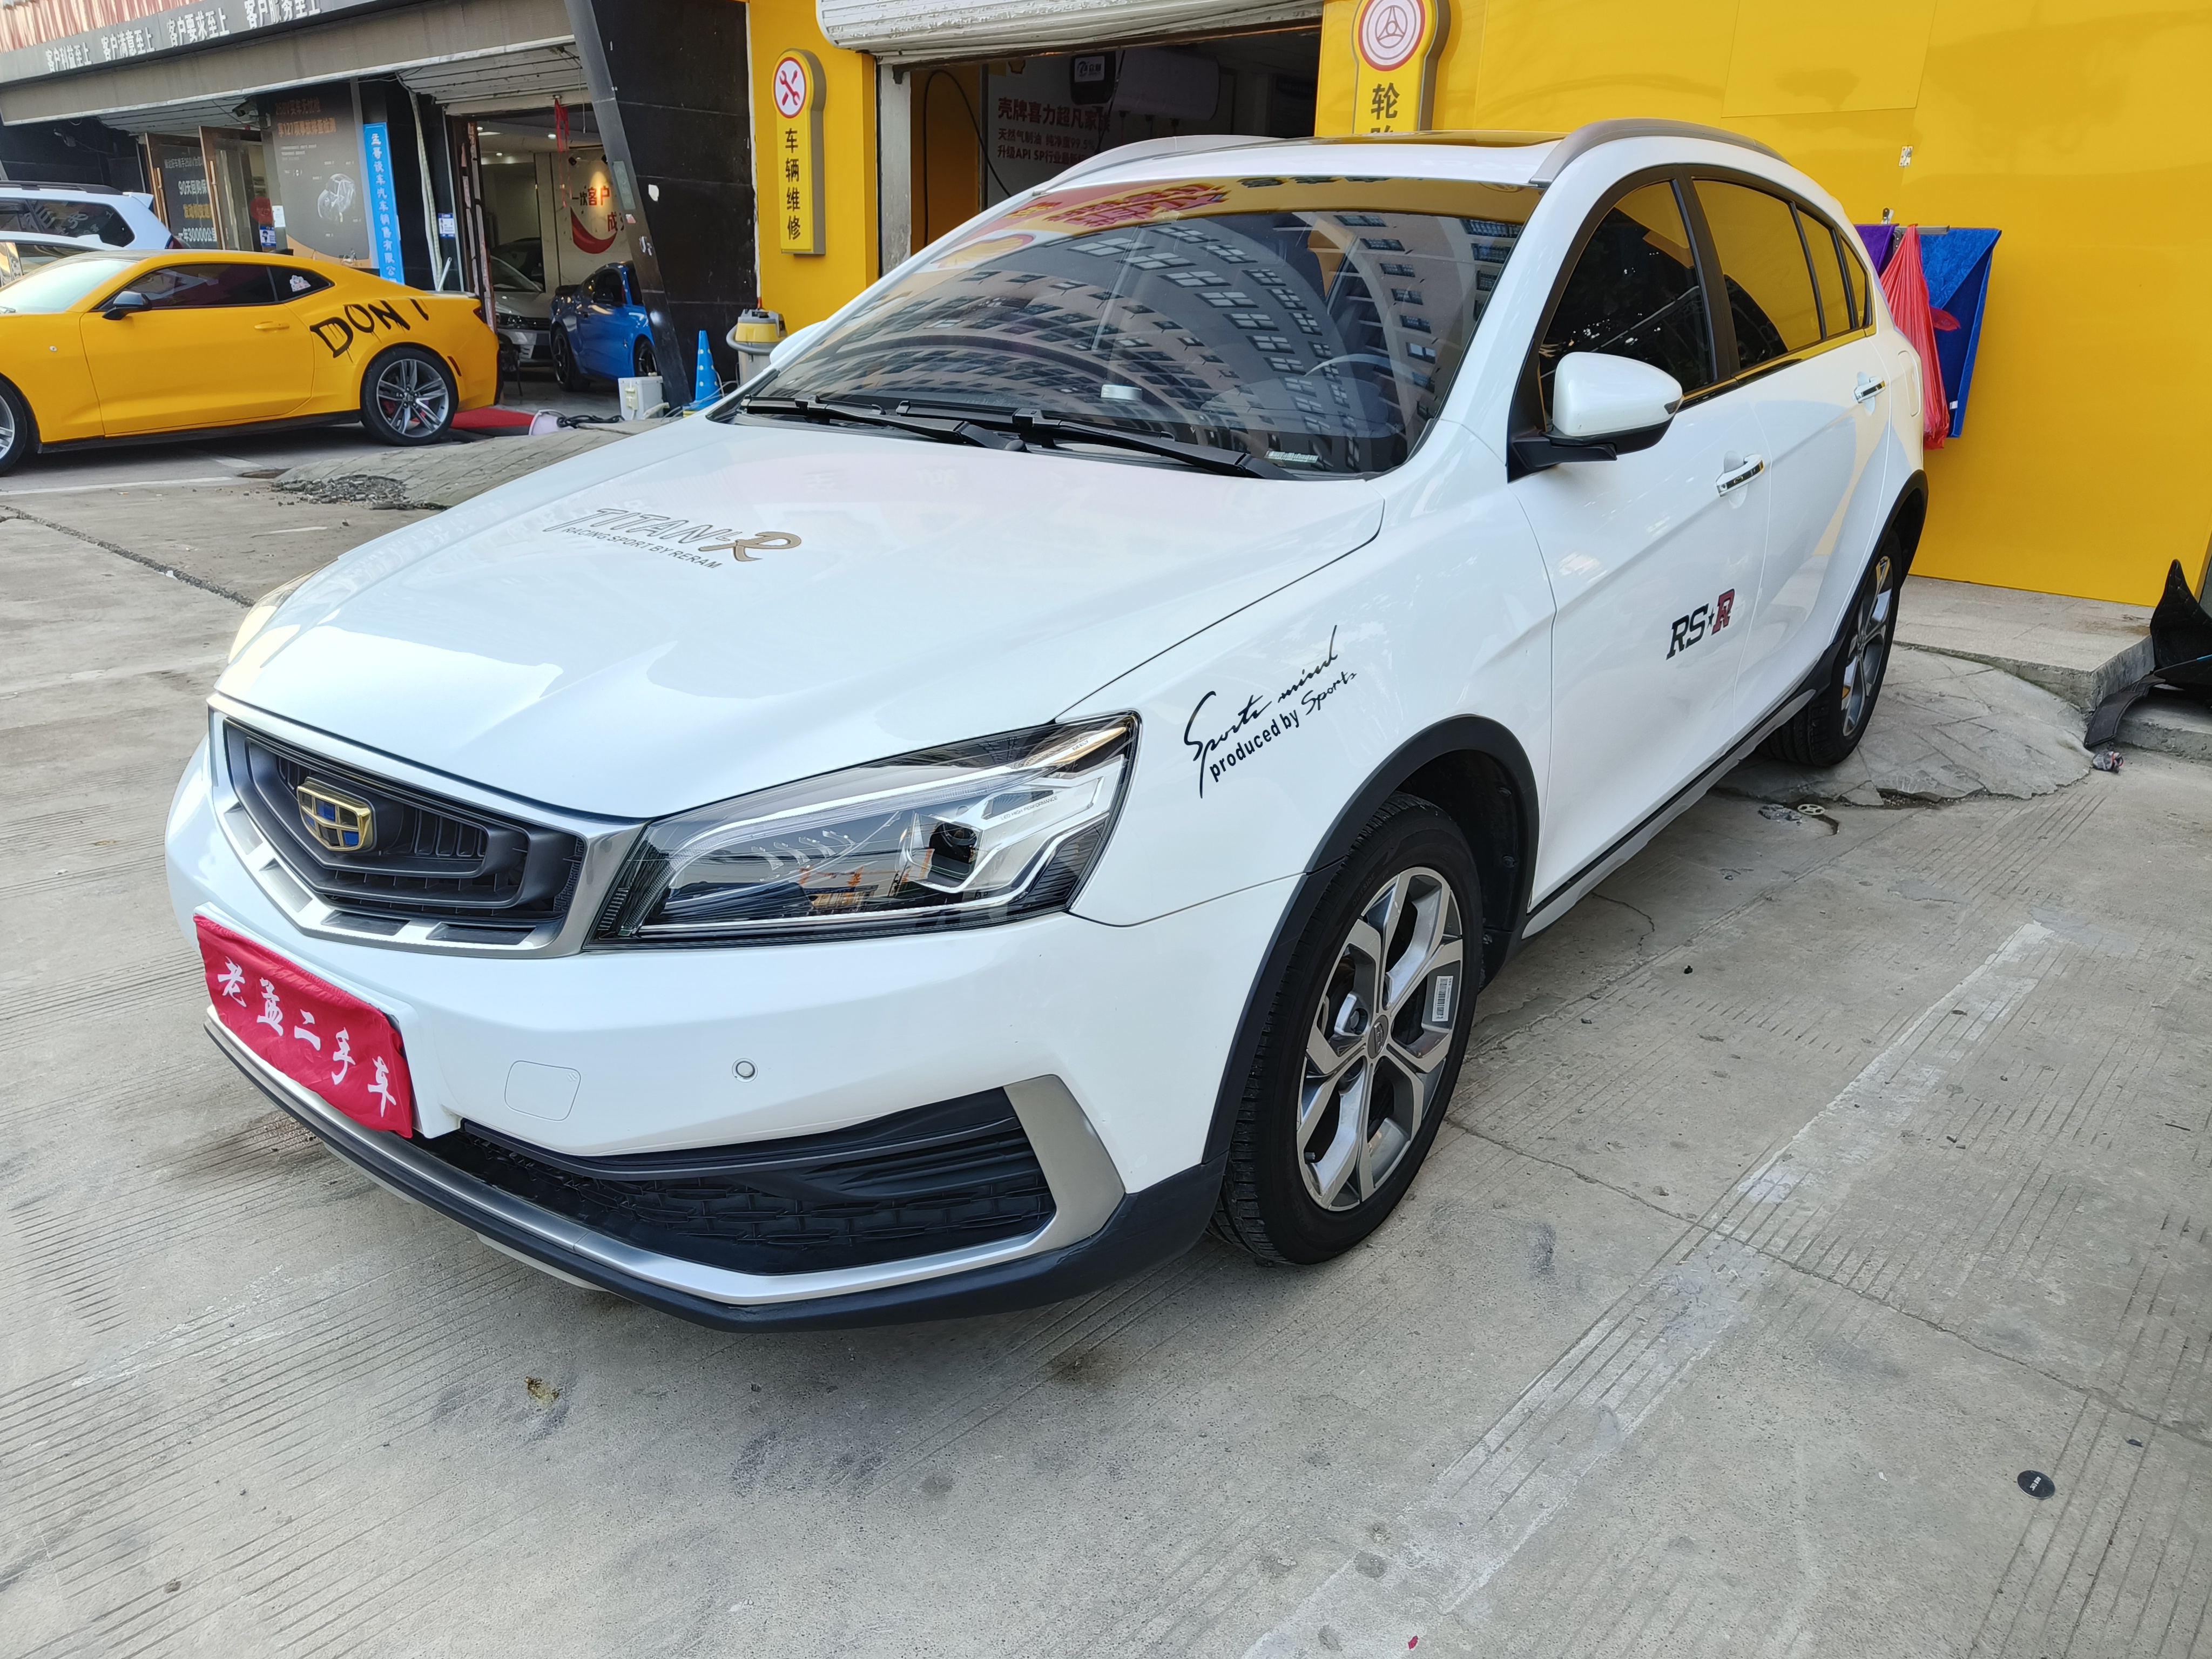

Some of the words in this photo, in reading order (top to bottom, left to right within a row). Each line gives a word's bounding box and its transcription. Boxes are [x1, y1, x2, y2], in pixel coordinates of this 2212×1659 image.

[46, 42, 92, 72] 客户利益至上
[101, 27, 156, 61] 客户满意至上
[167, 8, 230, 47] 客户要求至上
[998, 97, 1111, 133] 壳牌喜力超凡家族
[1371, 83, 1400, 133] 轮
[998, 128, 1042, 145] 天然气制油
[785, 128, 801, 240] 车辆维修
[562, 527, 610, 539] RACING
[607, 535, 655, 549] SPORT
[649, 545, 673, 554] BY
[667, 550, 723, 569] RERAM
[1278, 624, 1338, 703] mind
[1210, 719, 1281, 783] produced
[1279, 709, 1299, 728] by
[1301, 671, 1357, 716] Sports
[1023, 795, 1058, 812] PERFORMANCE
[1352, 872, 1375, 906] OUTSIDE
